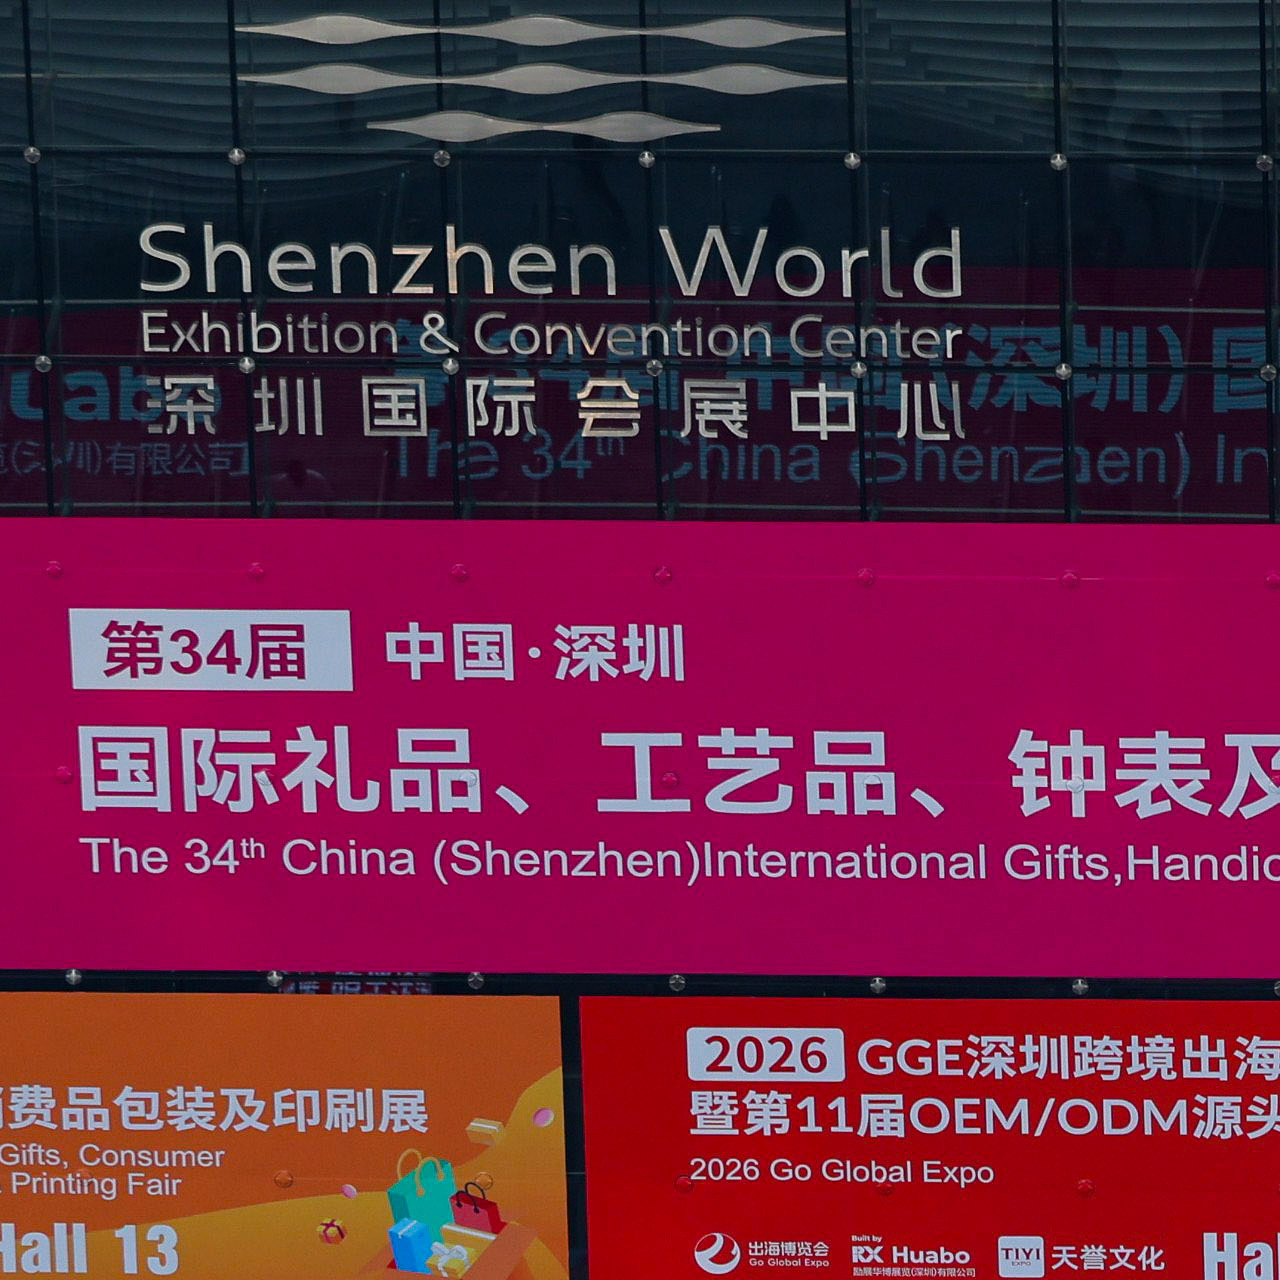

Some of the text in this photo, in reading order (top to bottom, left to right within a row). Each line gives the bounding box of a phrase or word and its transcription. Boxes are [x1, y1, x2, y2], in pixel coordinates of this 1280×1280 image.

[138, 223, 963, 299] Shenzhen World
[142, 310, 963, 361] Exhibition & Convention Center
[147, 374, 966, 442] 深圳国际会展中心
[101, 620, 306, 681] 第34届
[385, 622, 684, 682] 中国·深圳
[80, 837, 168, 875] The
[183, 836, 266, 875] 34th
[282, 838, 415, 876] China
[703, 1035, 828, 1074] 2026
[79, 1142, 225, 1167] Consumer
[11, 1170, 119, 1200] Printing
[127, 1172, 182, 1195] Fair
[690, 1157, 995, 1189] 2026 Go Global Expo
[114, 1224, 180, 1276] 13
[747, 1240, 830, 1259] 出海博览会
[851, 1234, 882, 1243] Built by
[1001, 1247, 1041, 1260] TIYI
[749, 1257, 830, 1268] Go Global Expo
[851, 1246, 970, 1264] RX Huabo
[1051, 1244, 1166, 1272] 天誉文化
